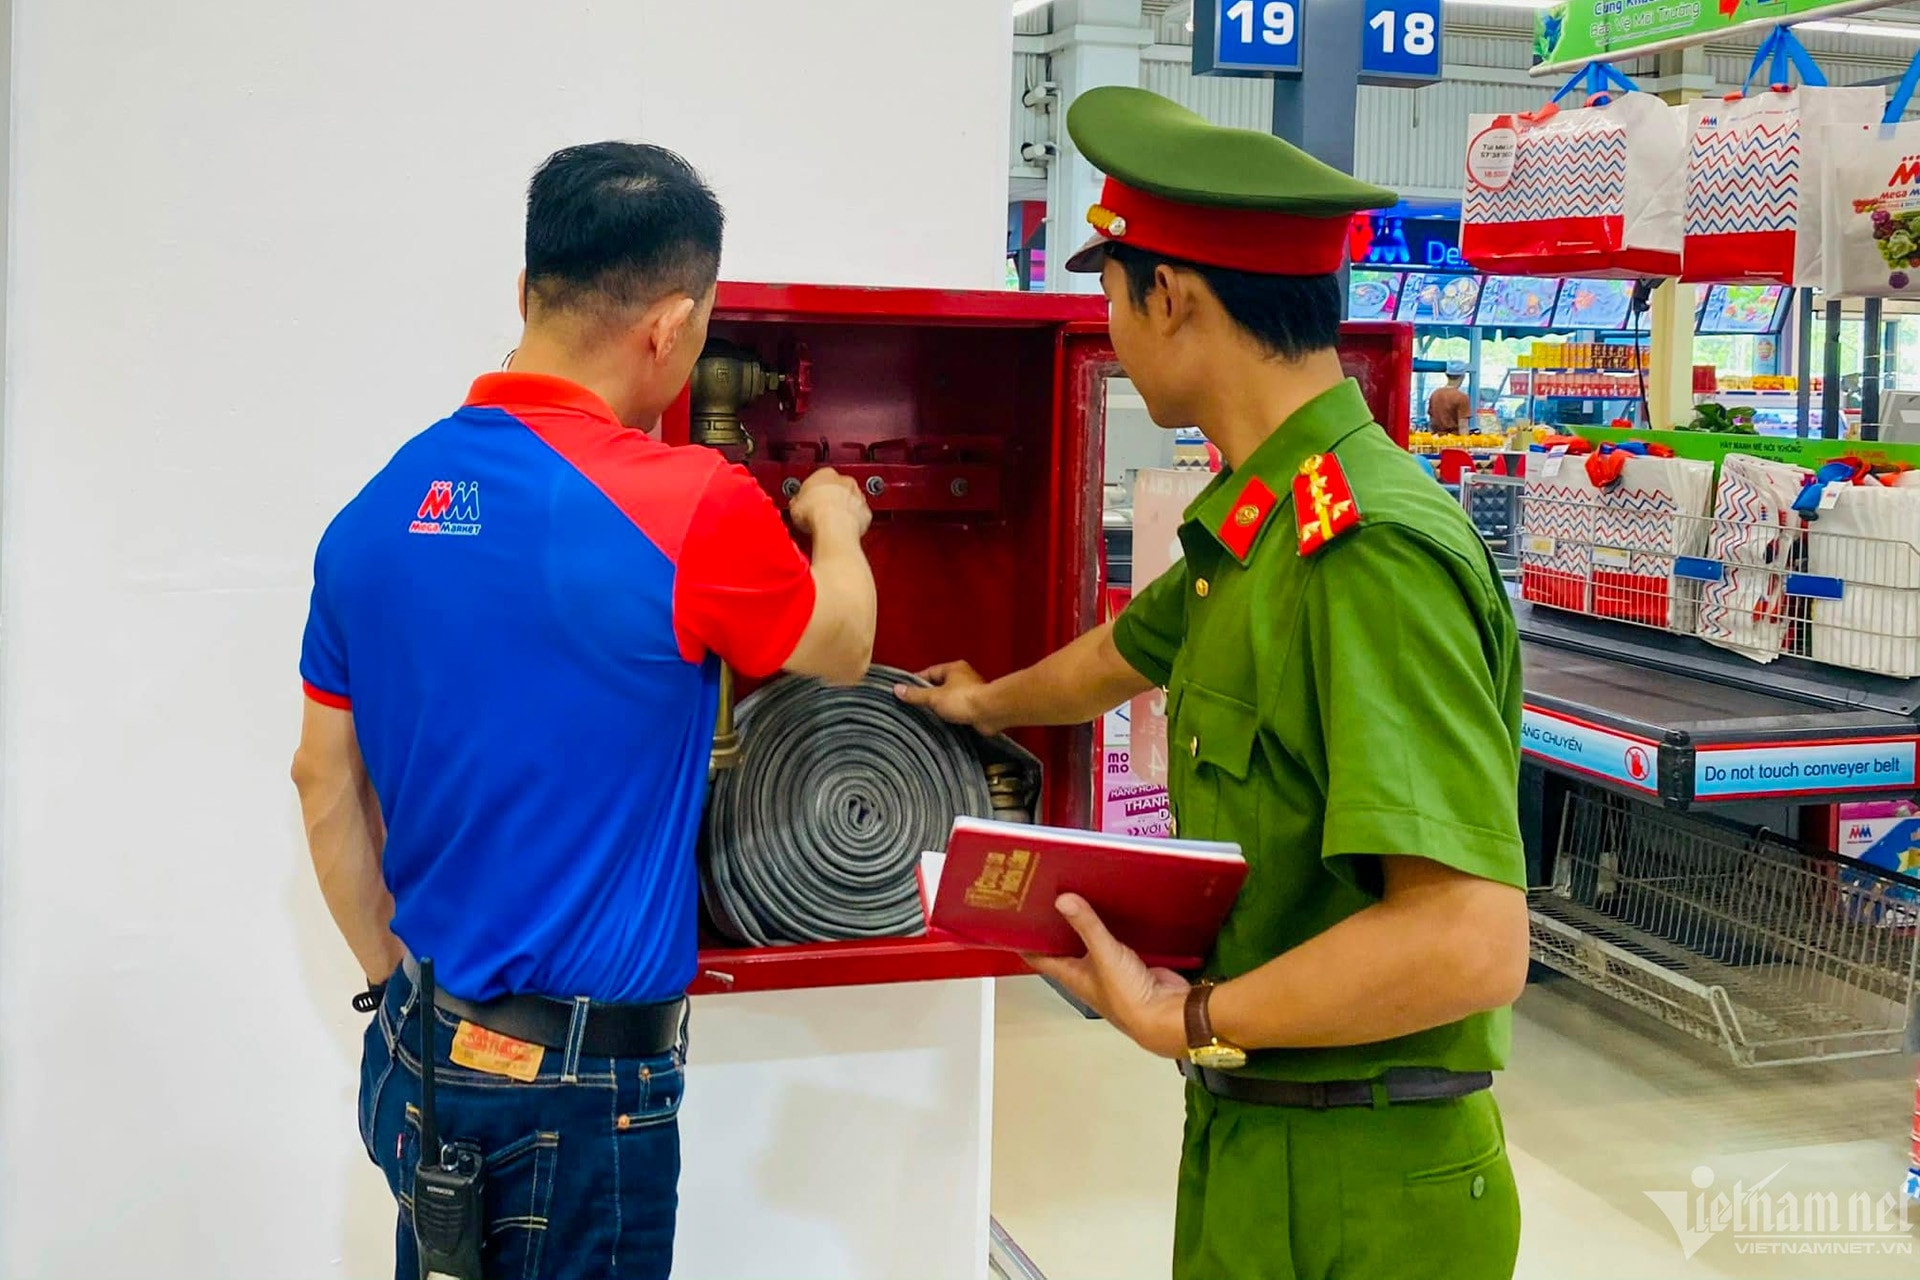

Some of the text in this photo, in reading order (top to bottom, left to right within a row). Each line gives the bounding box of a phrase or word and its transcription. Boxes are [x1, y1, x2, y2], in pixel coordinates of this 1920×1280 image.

[1227, 0, 1295, 45] 19
[1369, 10, 1435, 56] 18
[1705, 757, 1900, 781] Do not touch conveyer belt
